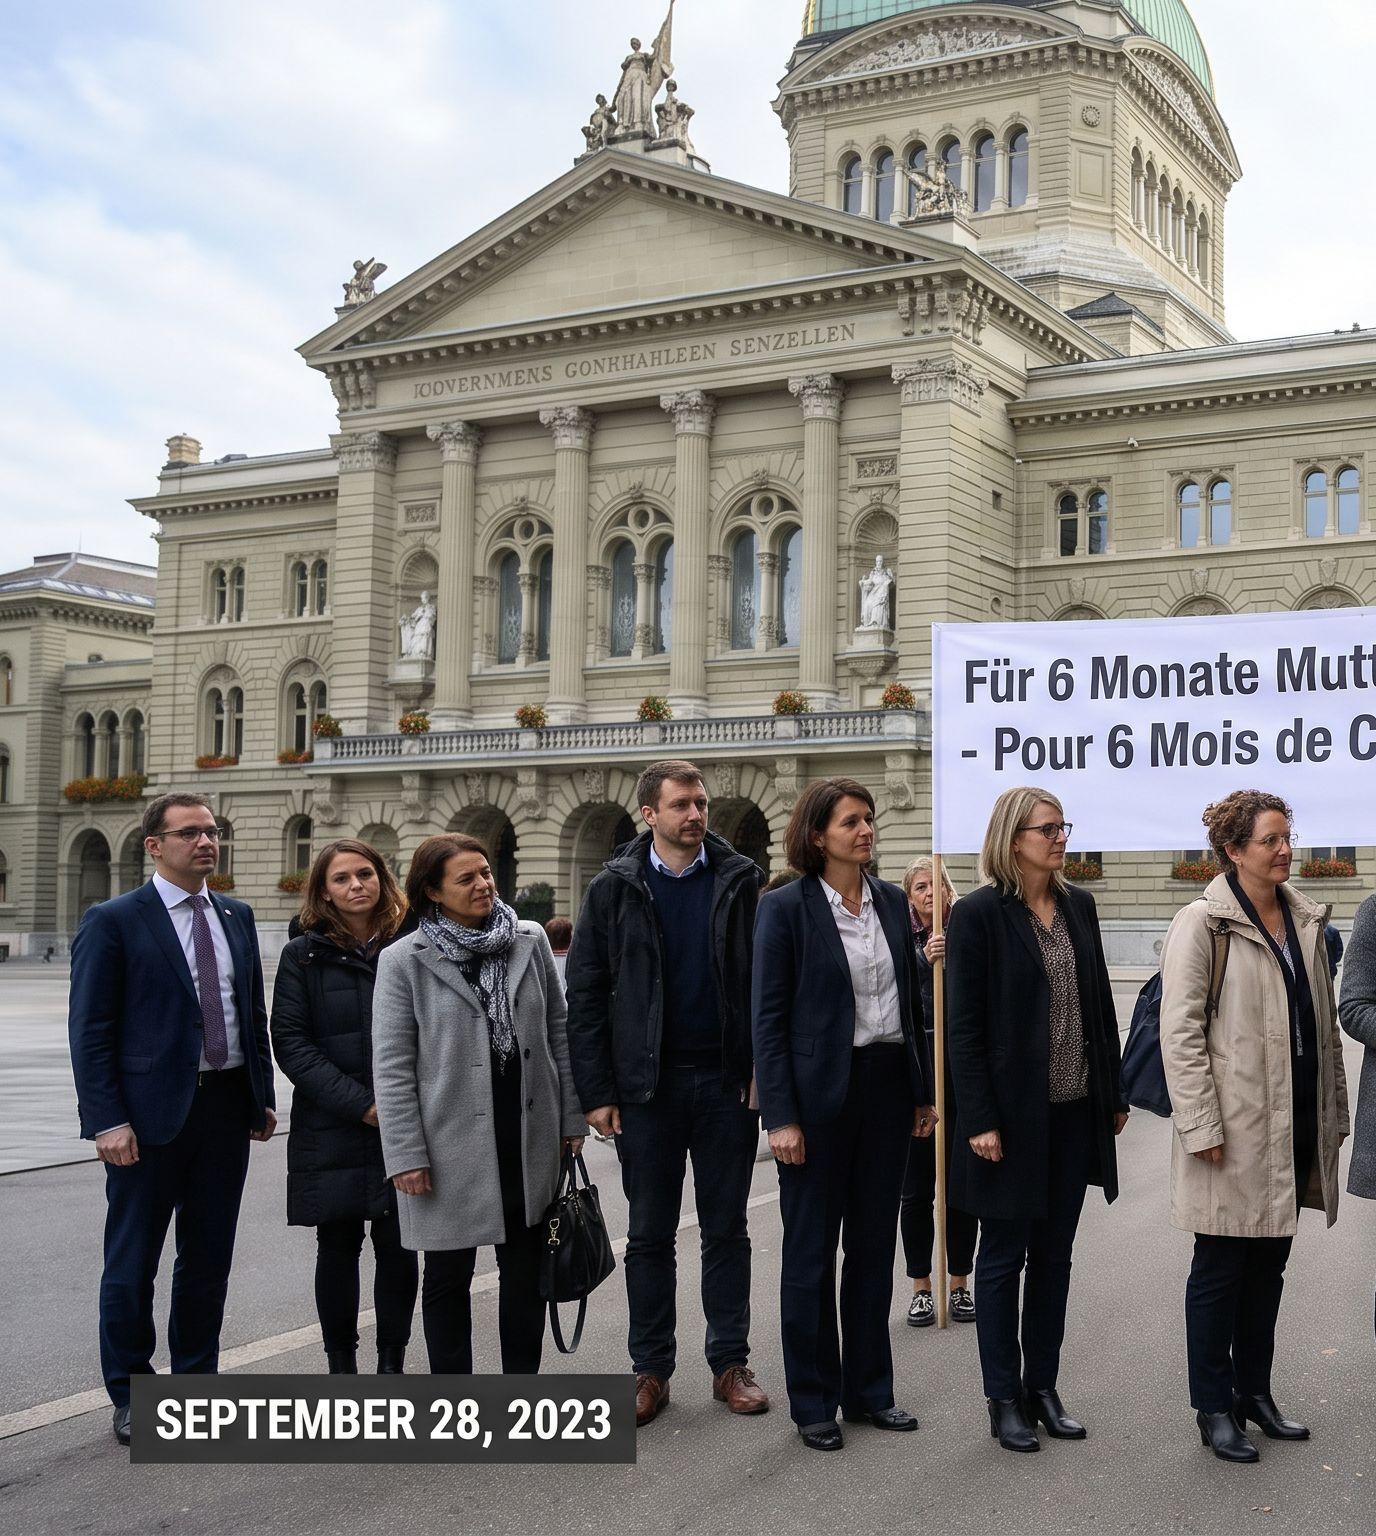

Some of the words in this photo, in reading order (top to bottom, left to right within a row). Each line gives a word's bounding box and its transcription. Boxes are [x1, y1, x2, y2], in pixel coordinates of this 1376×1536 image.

[730, 323, 856, 356] SENZELLEN
[965, 658, 1035, 703] Für
[1049, 658, 1075, 702] 6
[1090, 652, 1259, 700] Monate
[961, 749, 978, 758] -
[994, 726, 1094, 771] Pour
[1107, 724, 1134, 769] 6
[1150, 719, 1259, 767] Mois
[1276, 717, 1332, 764] de
